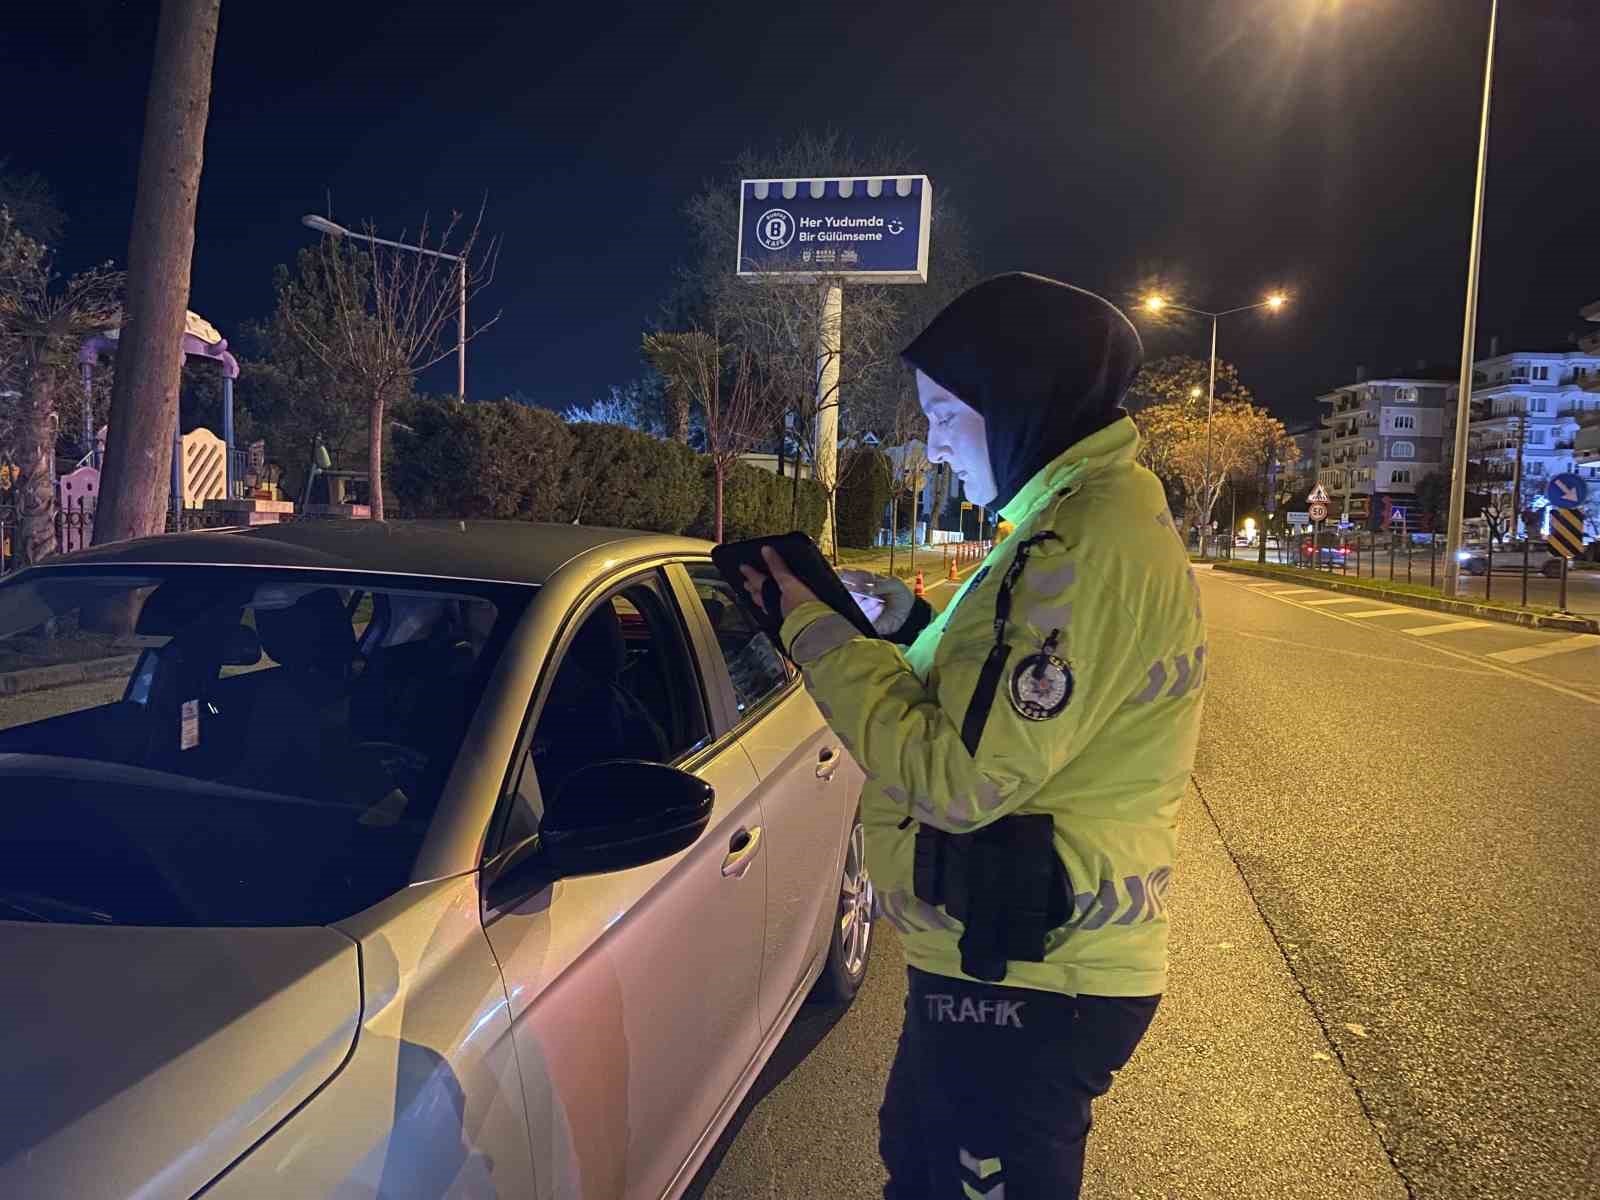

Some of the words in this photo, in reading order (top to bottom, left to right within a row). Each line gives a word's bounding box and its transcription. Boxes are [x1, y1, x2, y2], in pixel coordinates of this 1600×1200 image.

[800, 217, 822, 227] Her
[825, 216, 884, 227] Yudumda
[799, 232, 816, 241] Bir
[818, 231, 883, 241] Gülümseme
[1312, 507, 1323, 516] 50
